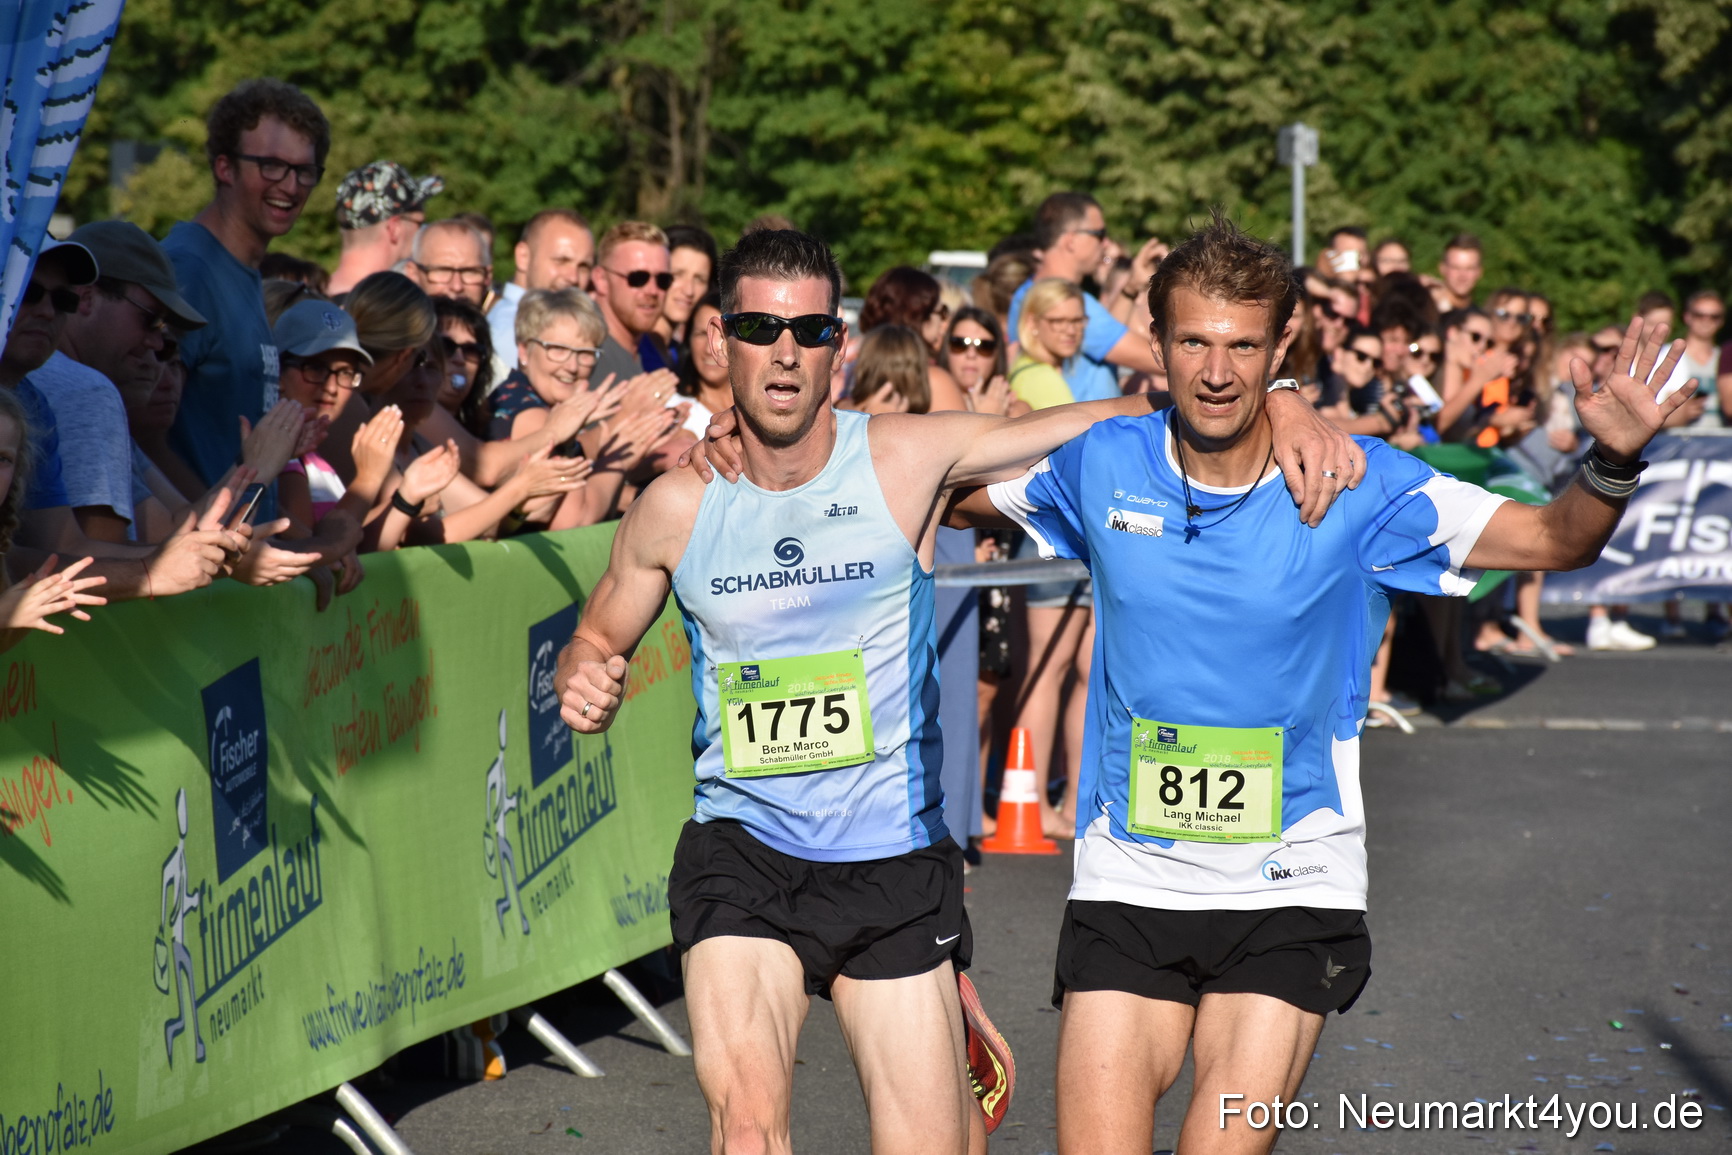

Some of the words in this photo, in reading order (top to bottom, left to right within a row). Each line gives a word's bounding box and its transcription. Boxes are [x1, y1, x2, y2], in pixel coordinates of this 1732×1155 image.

[1633, 502, 1732, 553] Fis
[711, 561, 875, 596] SCHABMÜLLER
[769, 595, 811, 611] TEAM
[734, 677, 780, 690] firmenlauf
[787, 681, 815, 694] 2018
[737, 693, 851, 743] 1775
[219, 728, 260, 776] Fischer
[762, 744, 791, 755] Benz
[793, 740, 829, 752] Marco
[1148, 738, 1198, 754] firmenlauf
[759, 752, 807, 765] Schabmüller
[808, 750, 834, 760] GmbH
[1203, 753, 1232, 764] 2018
[1158, 765, 1246, 810] 812
[1163, 808, 1192, 823] Lang
[1195, 811, 1241, 823] Michael
[1178, 822, 1193, 830] IKK
[1194, 823, 1223, 832] classic
[199, 792, 323, 993] firmenlauf
[209, 964, 265, 1045] neumarkt
